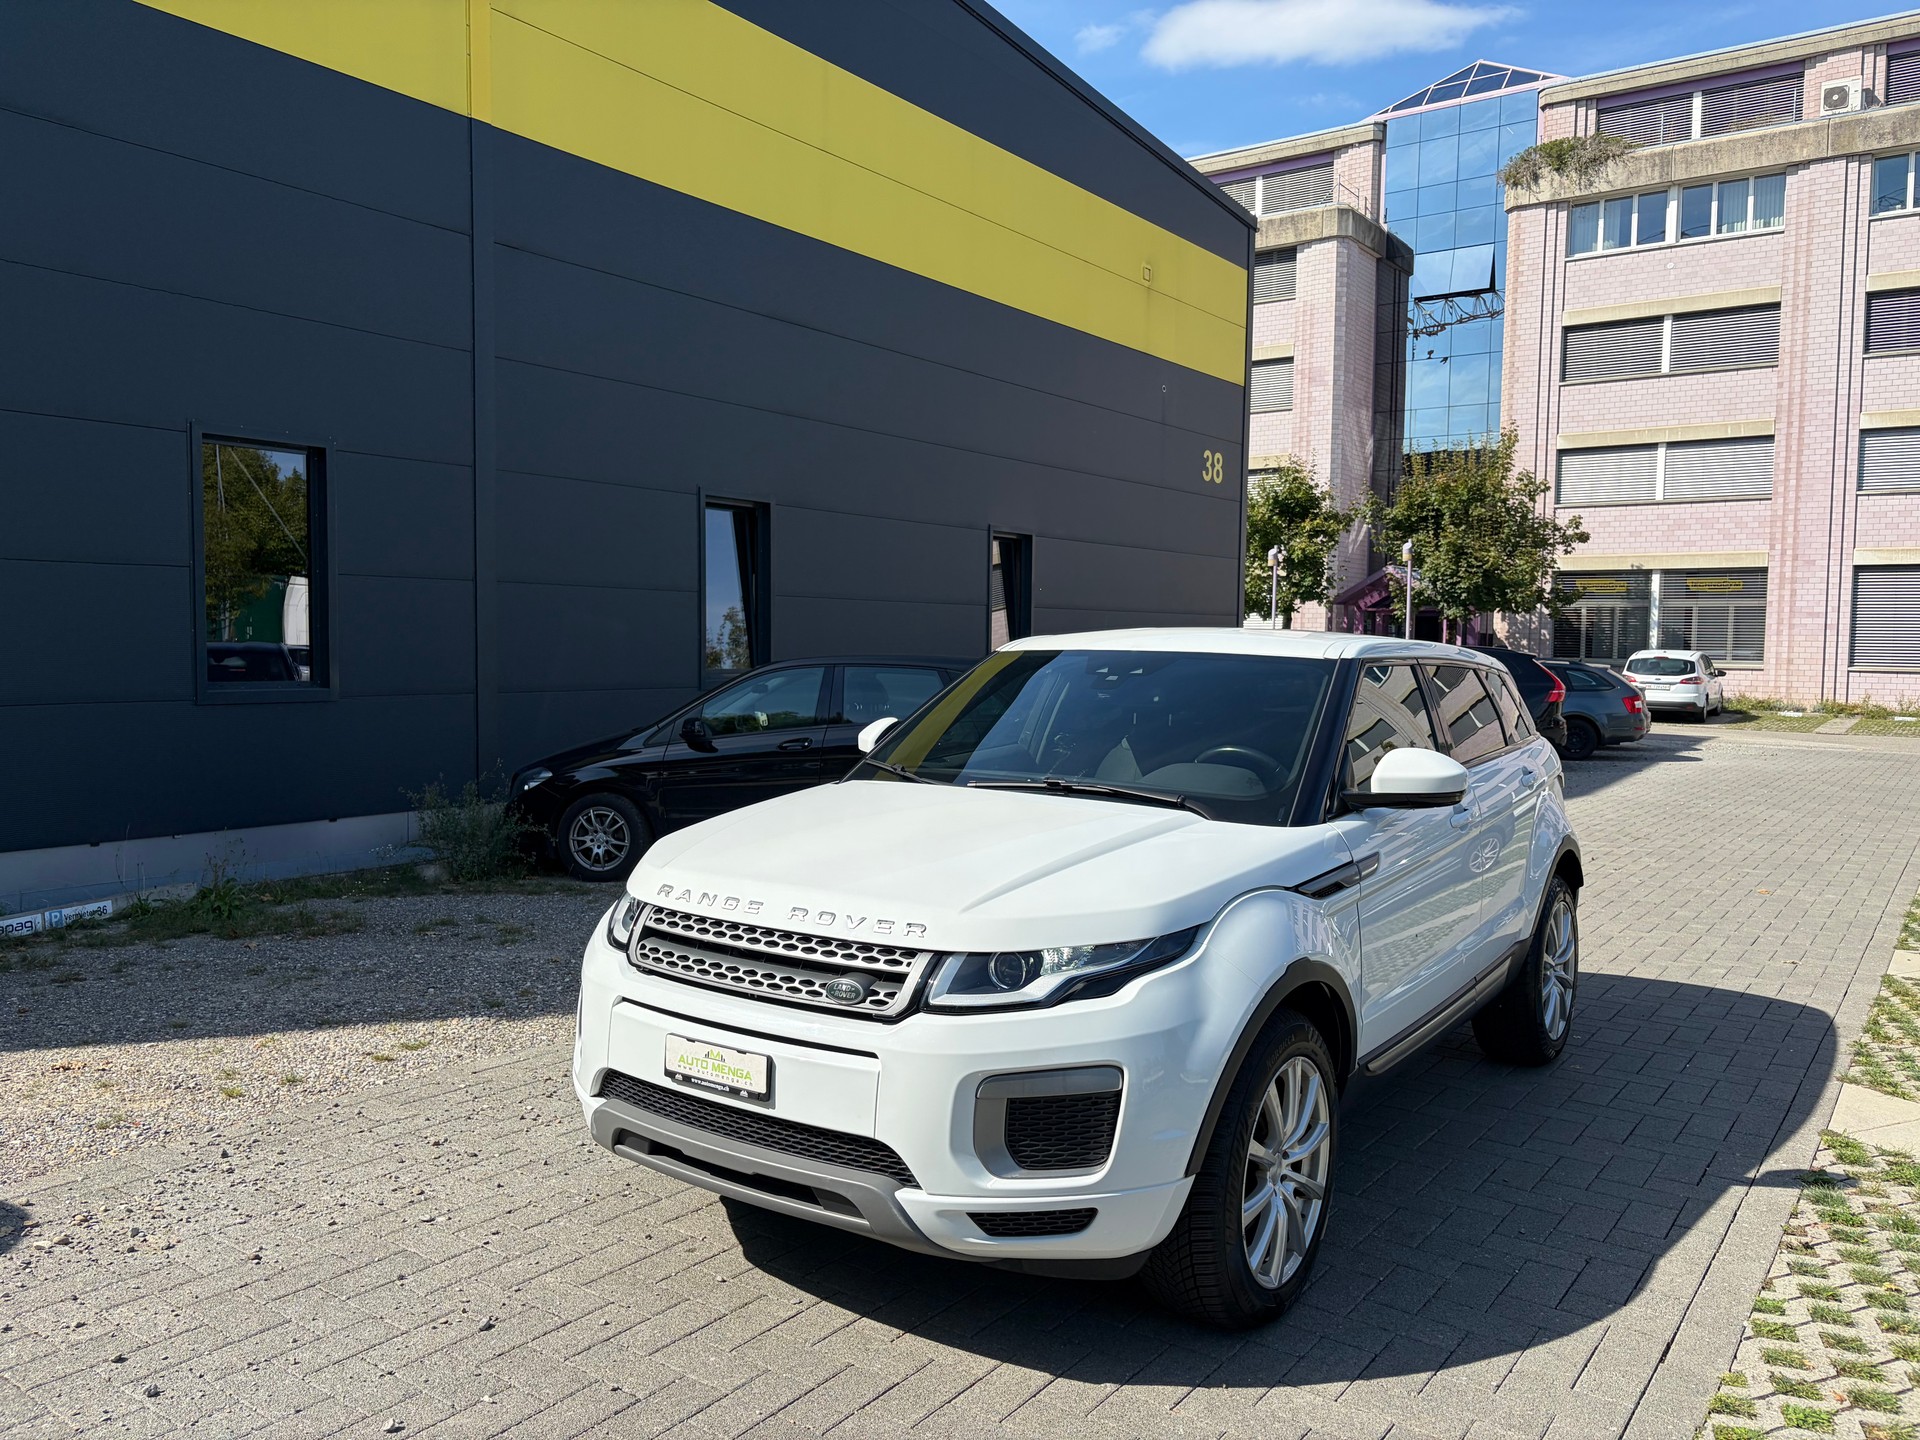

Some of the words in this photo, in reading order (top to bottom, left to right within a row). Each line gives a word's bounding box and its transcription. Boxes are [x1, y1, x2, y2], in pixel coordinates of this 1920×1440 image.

[1202, 449, 1223, 484] 38
[51, 912, 60, 927] P
[97, 905, 108, 917] 36
[656, 883, 764, 915] RANGE
[787, 906, 927, 938] ROVER
[833, 983, 851, 992] LAND
[834, 991, 856, 999] ROVER
[678, 1054, 709, 1070] AUTO
[711, 1061, 753, 1081] MENGA
